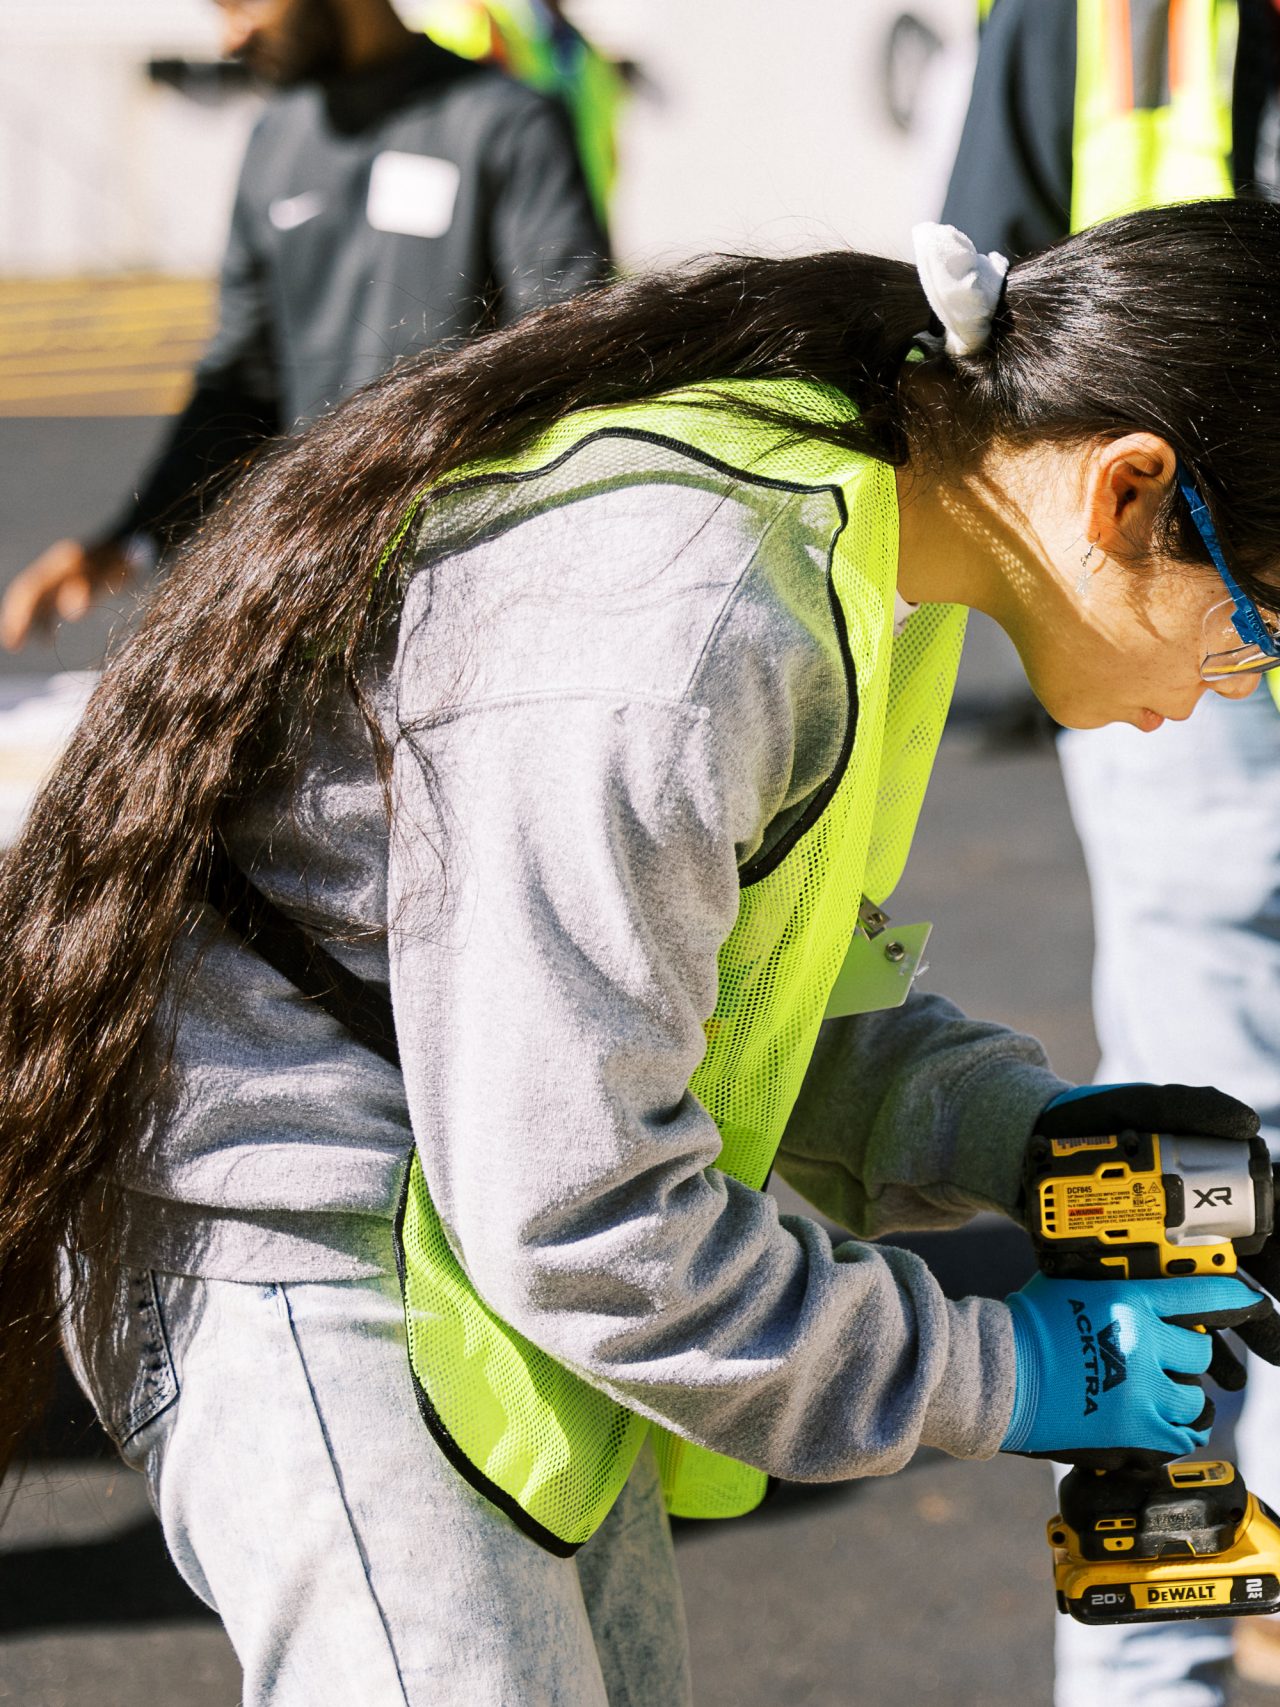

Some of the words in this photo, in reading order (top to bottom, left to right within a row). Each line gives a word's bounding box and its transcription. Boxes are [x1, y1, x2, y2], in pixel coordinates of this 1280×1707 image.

[1192, 1187, 1233, 1208] XR
[1068, 1298, 1098, 1417] ACKTRA
[1245, 1578, 1263, 1592] 2
